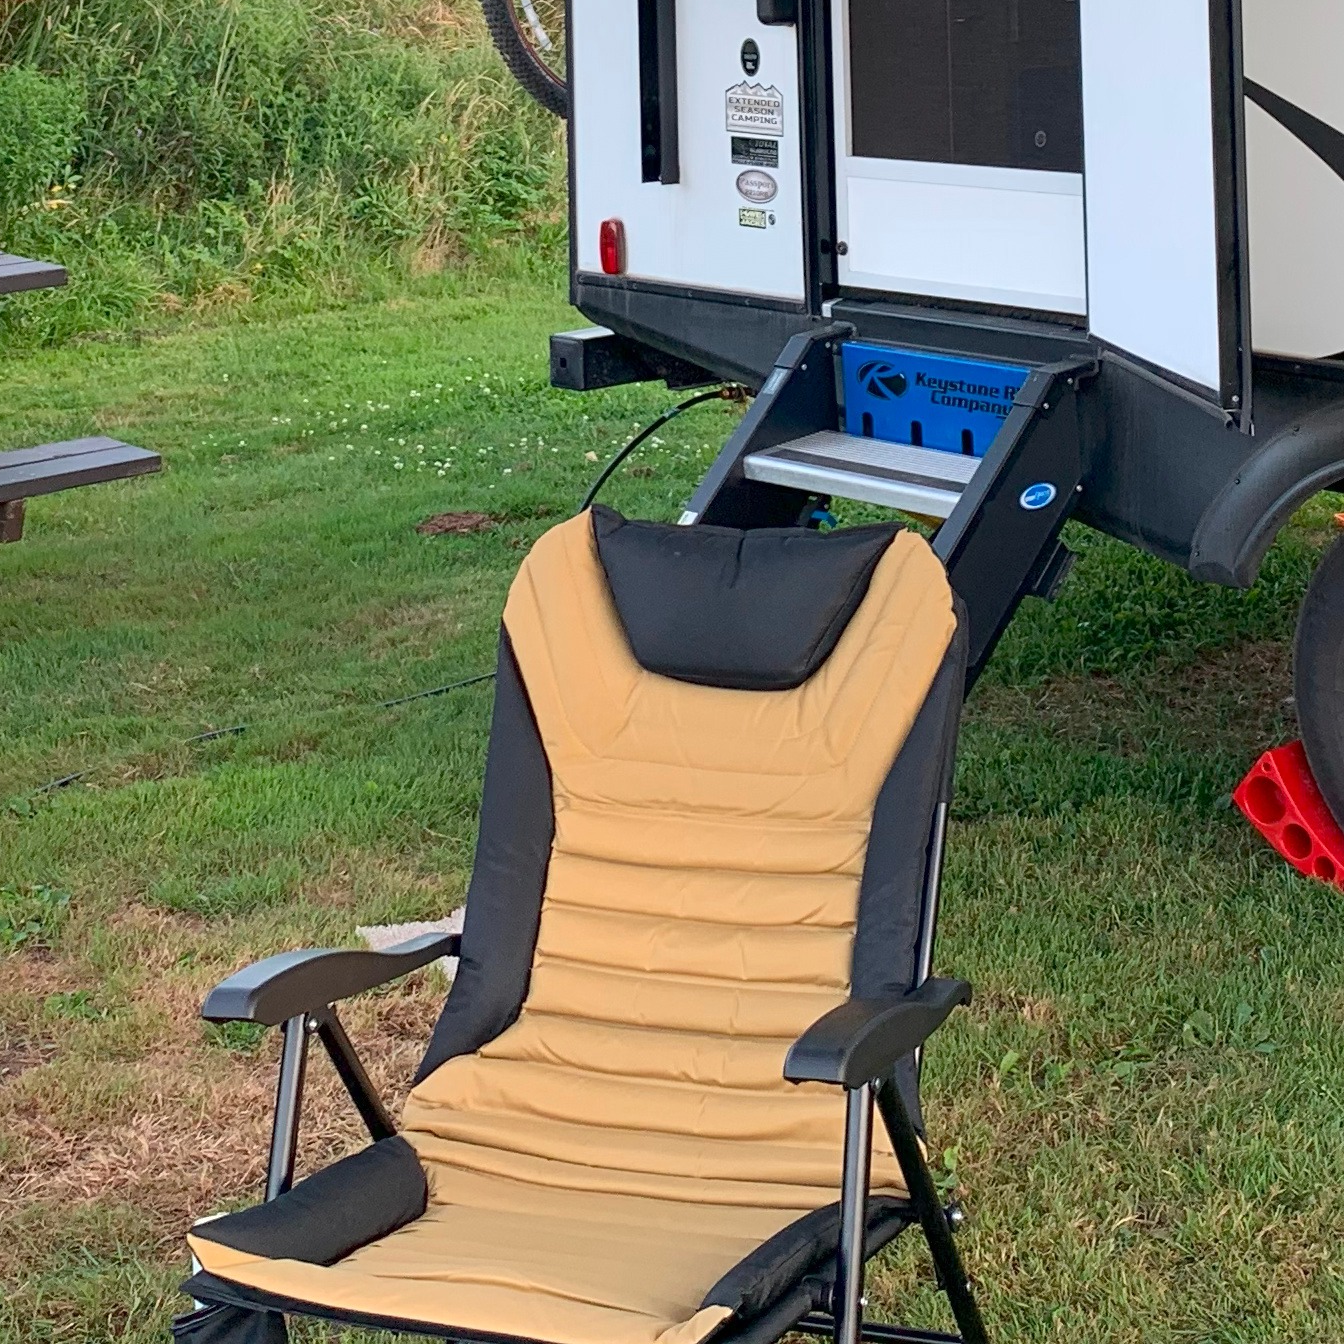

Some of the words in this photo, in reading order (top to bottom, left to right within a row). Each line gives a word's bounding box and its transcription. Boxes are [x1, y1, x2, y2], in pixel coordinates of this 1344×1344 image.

[728, 96, 780, 107] EXTENDED
[734, 105, 774, 115] SEASON
[731, 113, 777, 124] CAMPING
[915, 371, 1000, 399] Keystone
[1003, 385, 1020, 401] R
